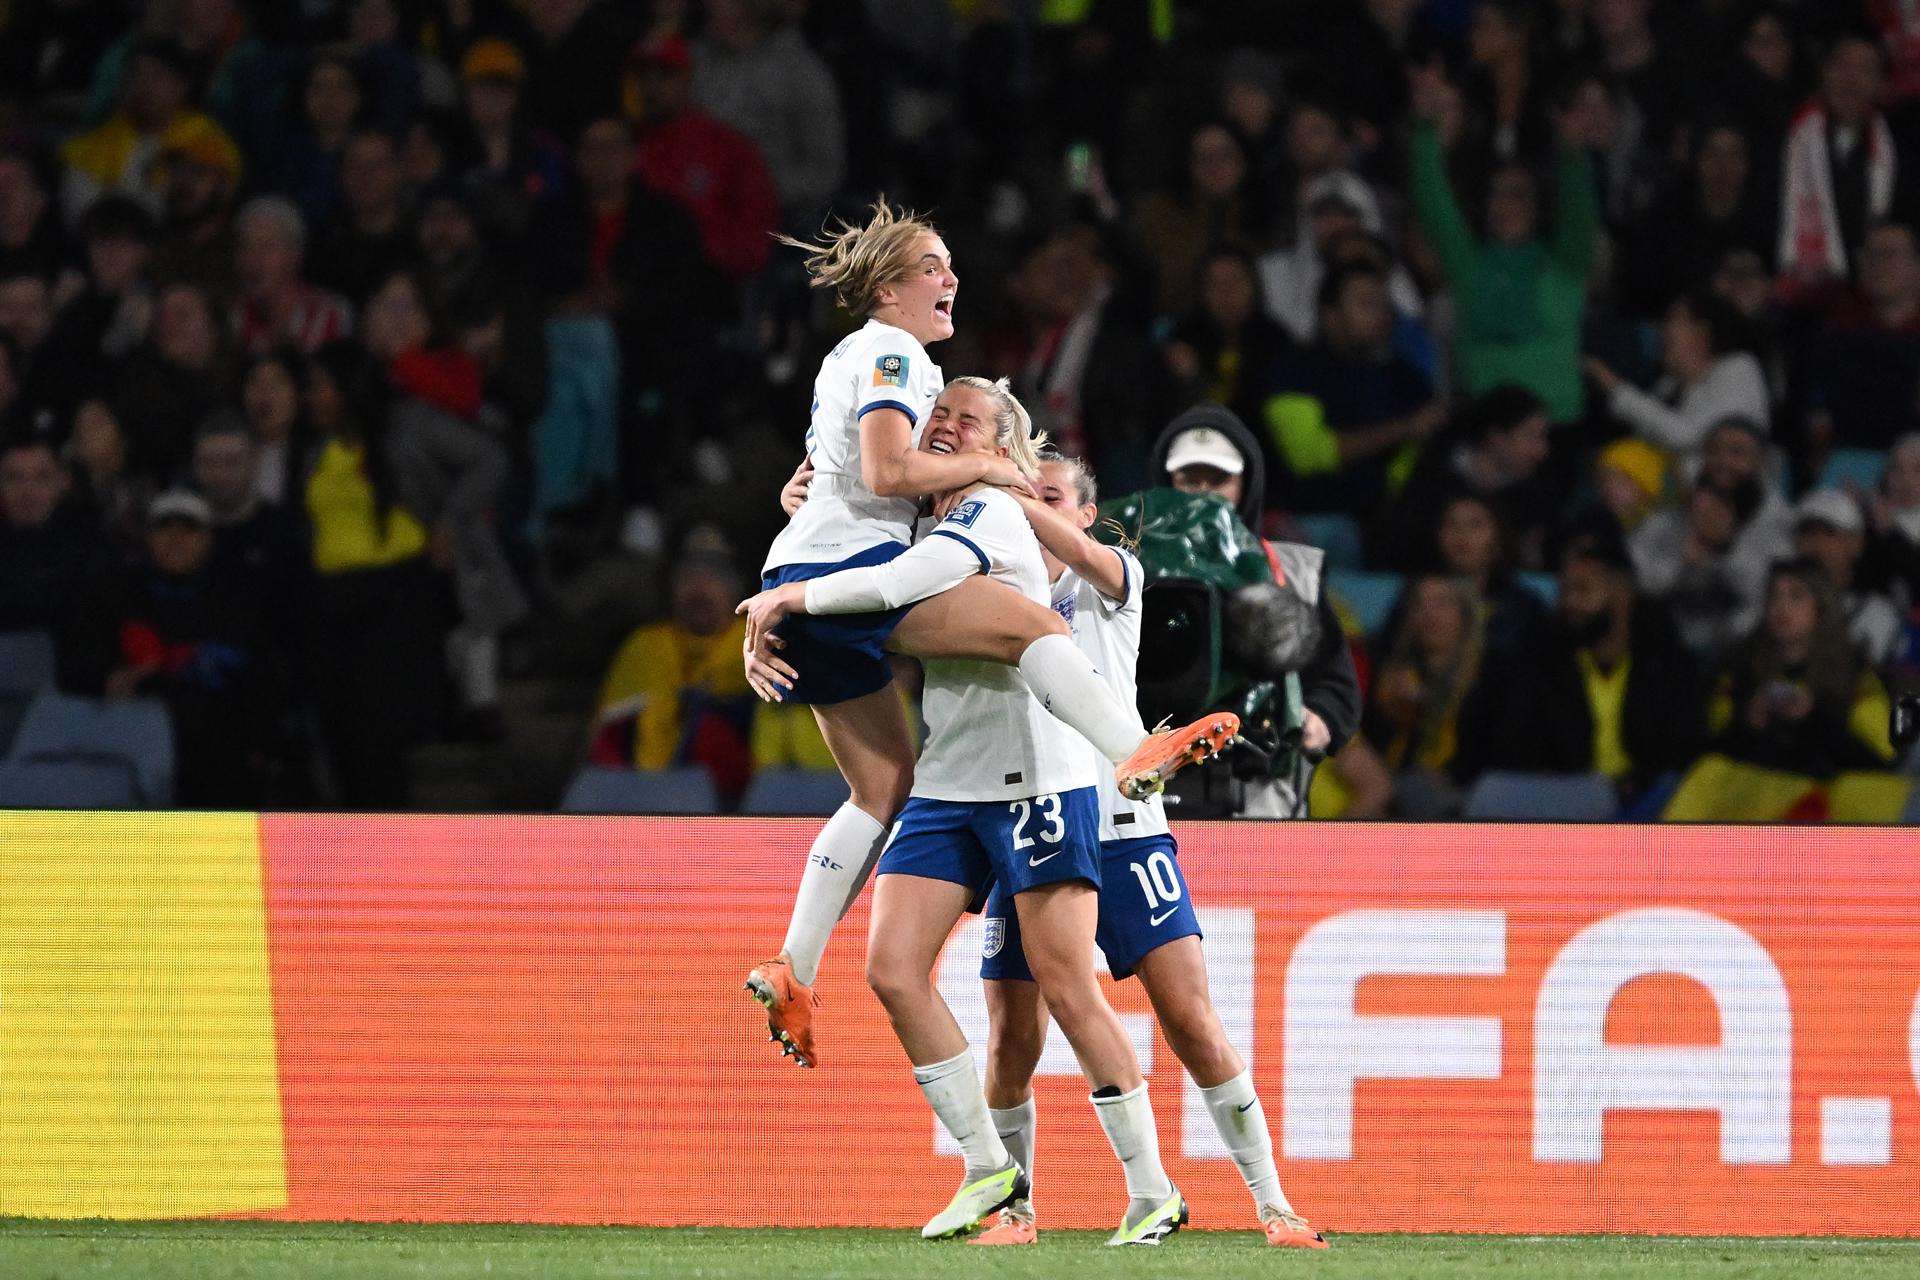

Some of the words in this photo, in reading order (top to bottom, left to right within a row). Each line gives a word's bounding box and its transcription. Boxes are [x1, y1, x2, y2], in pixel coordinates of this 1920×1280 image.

[1009, 793, 1065, 851] 23
[1130, 851, 1182, 909] 10
[932, 906, 1920, 1165] IFA.
